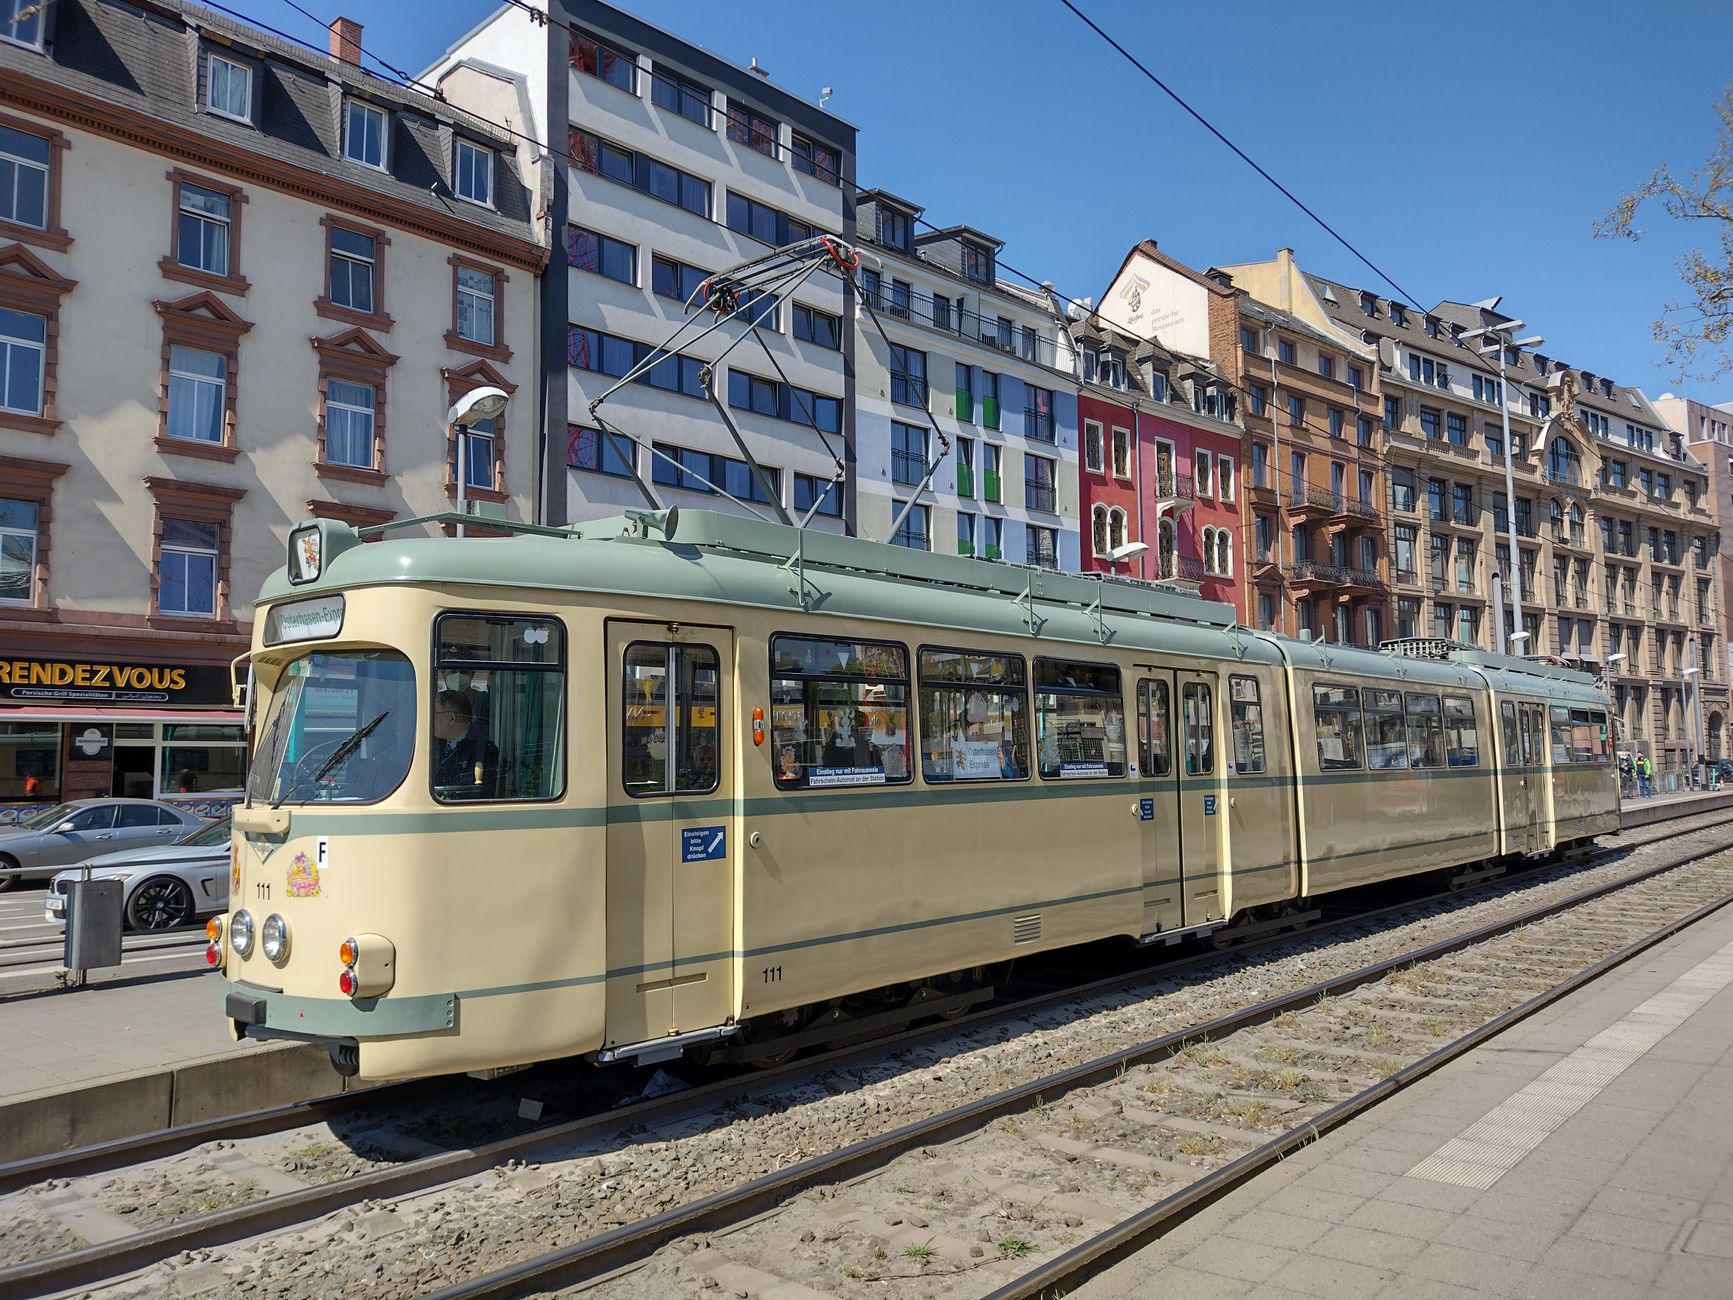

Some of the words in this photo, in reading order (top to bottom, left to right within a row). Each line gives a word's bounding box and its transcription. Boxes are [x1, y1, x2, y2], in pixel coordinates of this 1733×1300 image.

[0, 661, 186, 690] RENDEZVOUS
[68, 691, 108, 699] Spezialitäten
[816, 768, 835, 776] Einstieg
[851, 766, 879, 774] Fahrausweis
[318, 841, 327, 862] F
[686, 852, 707, 860] drücken
[256, 882, 271, 900] 111
[762, 965, 782, 984] 111
